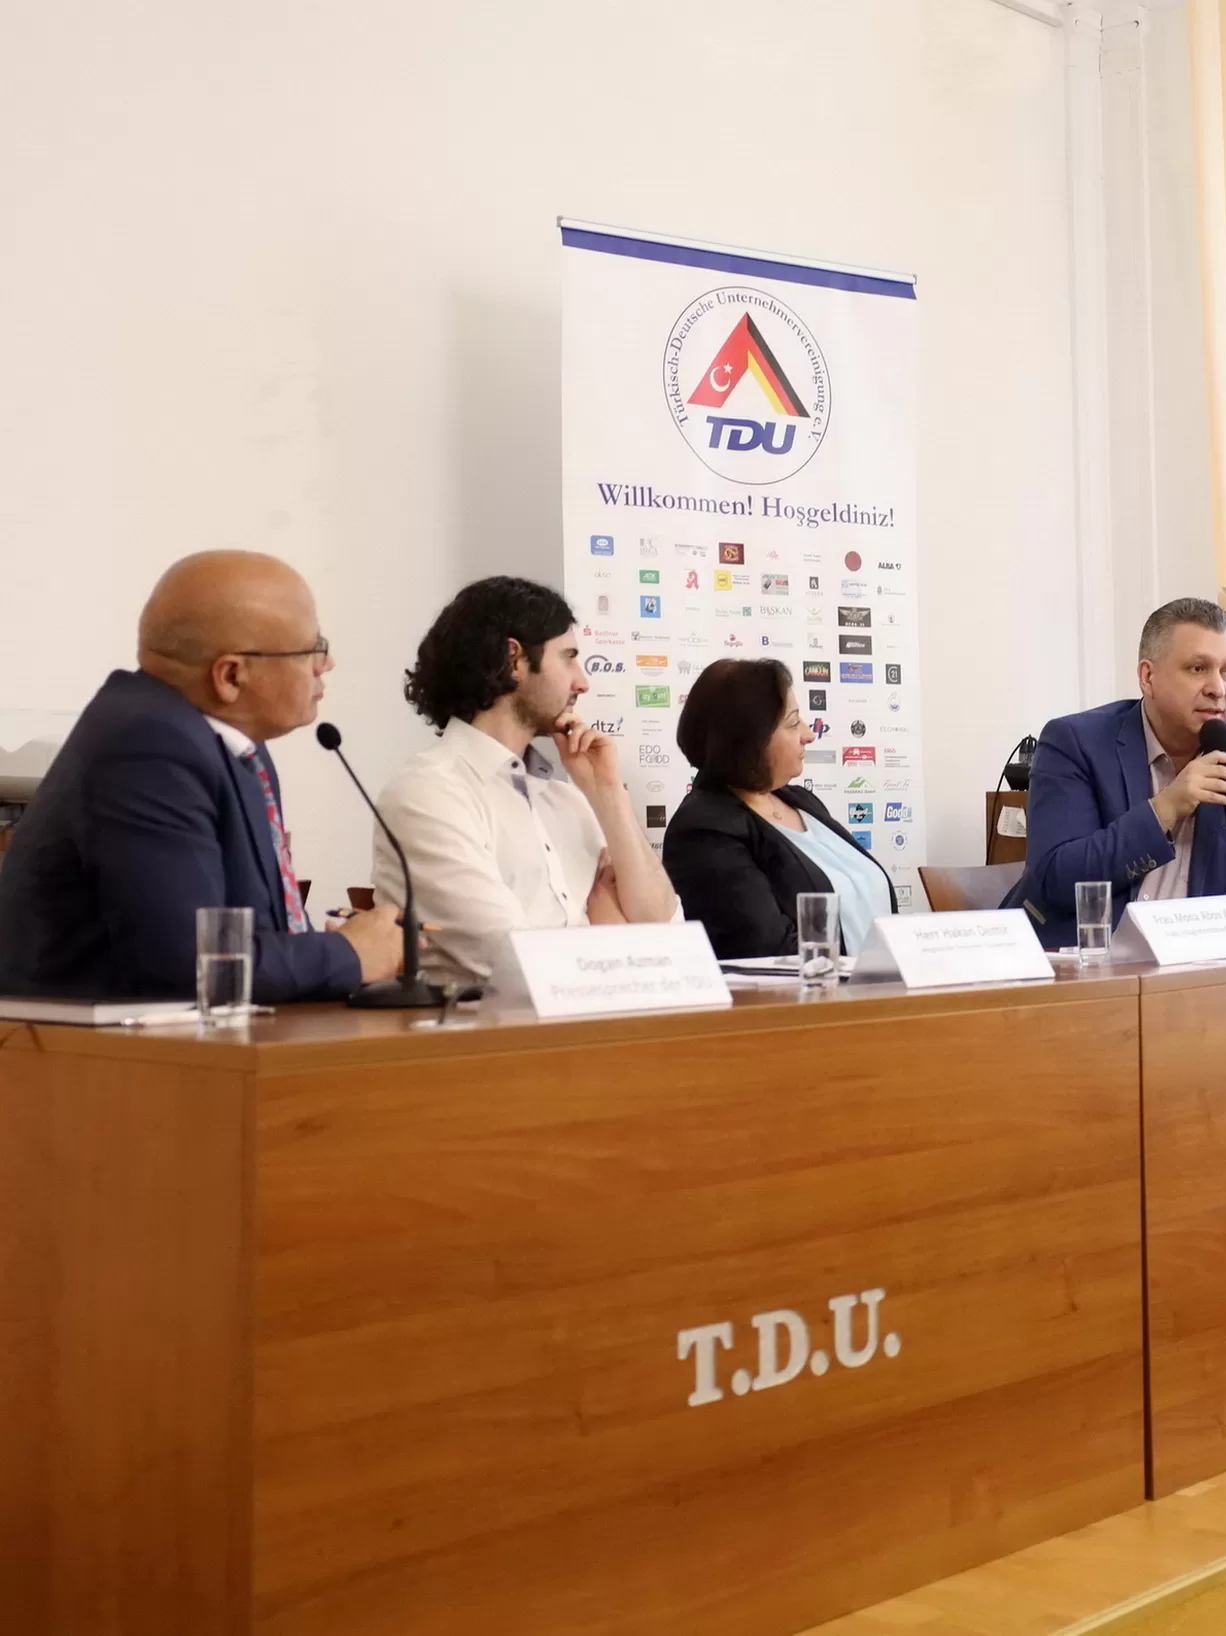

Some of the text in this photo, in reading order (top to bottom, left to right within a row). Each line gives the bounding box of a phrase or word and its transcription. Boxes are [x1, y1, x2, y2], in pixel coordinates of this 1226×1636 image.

[667, 300, 716, 428] Türkisch-Deutsche
[715, 291, 826, 414] Unternehmervereinigung
[706, 415, 797, 455] TDU
[597, 482, 895, 528] Willkommen! Hoşgeldiniz!
[591, 661, 626, 673] B.O.S.
[639, 745, 661, 754] EDO
[677, 1287, 901, 1407] T.D.U.
